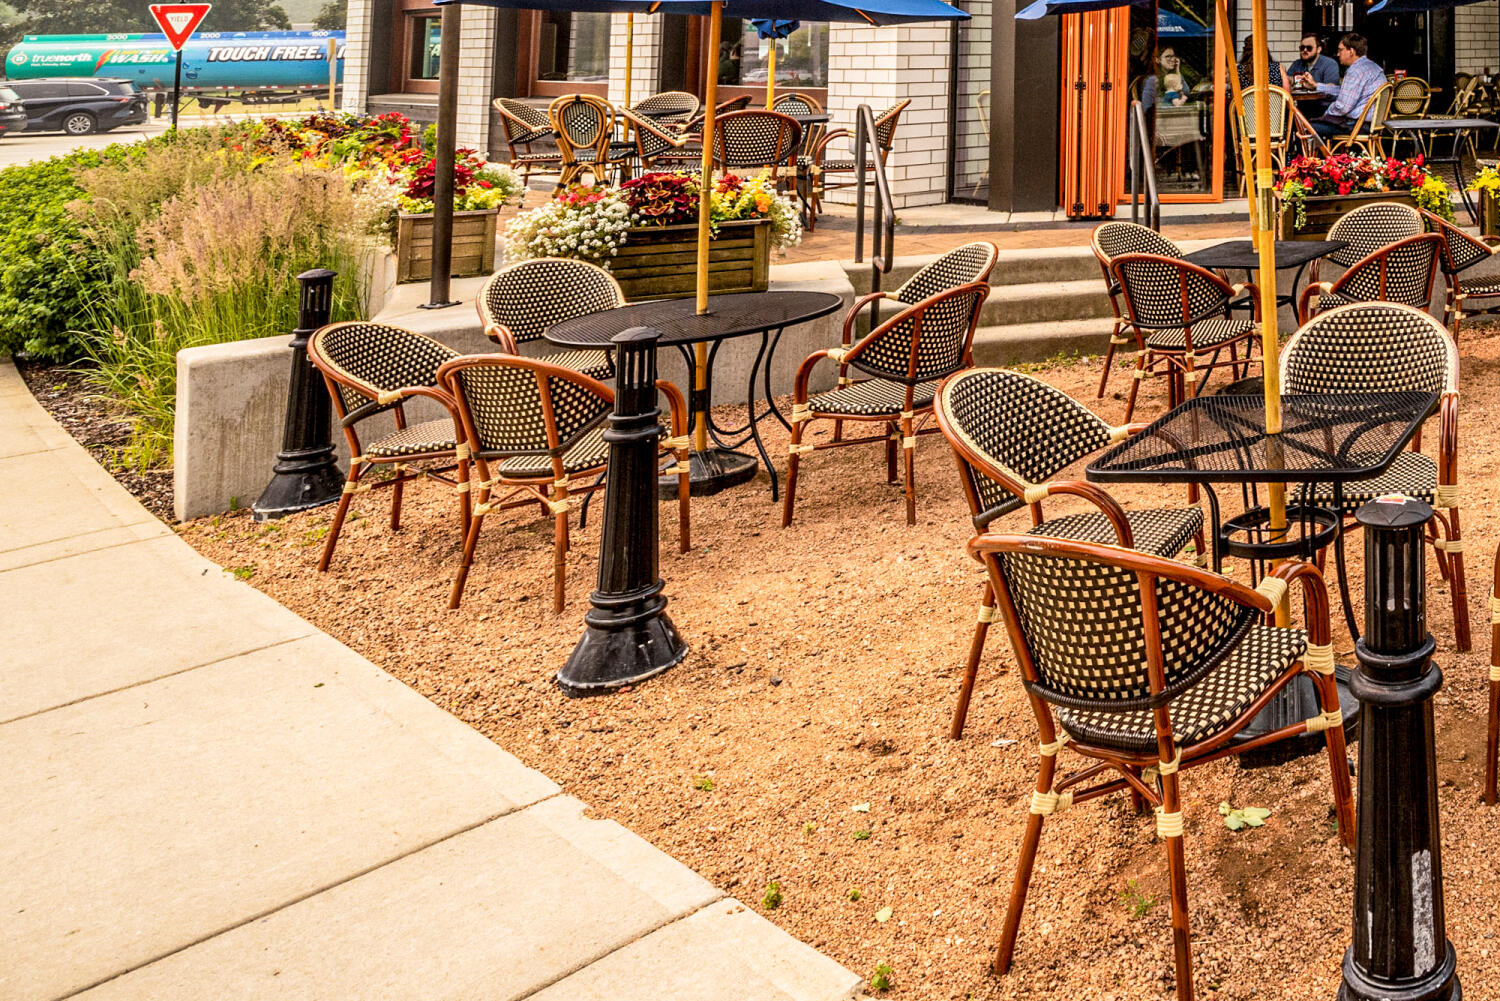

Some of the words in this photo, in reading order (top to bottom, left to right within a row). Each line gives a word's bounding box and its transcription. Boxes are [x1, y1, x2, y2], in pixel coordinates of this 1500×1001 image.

[32, 53, 92, 63] truenorth
[208, 47, 270, 62] TOUCH
[271, 45, 323, 60] FREE.
